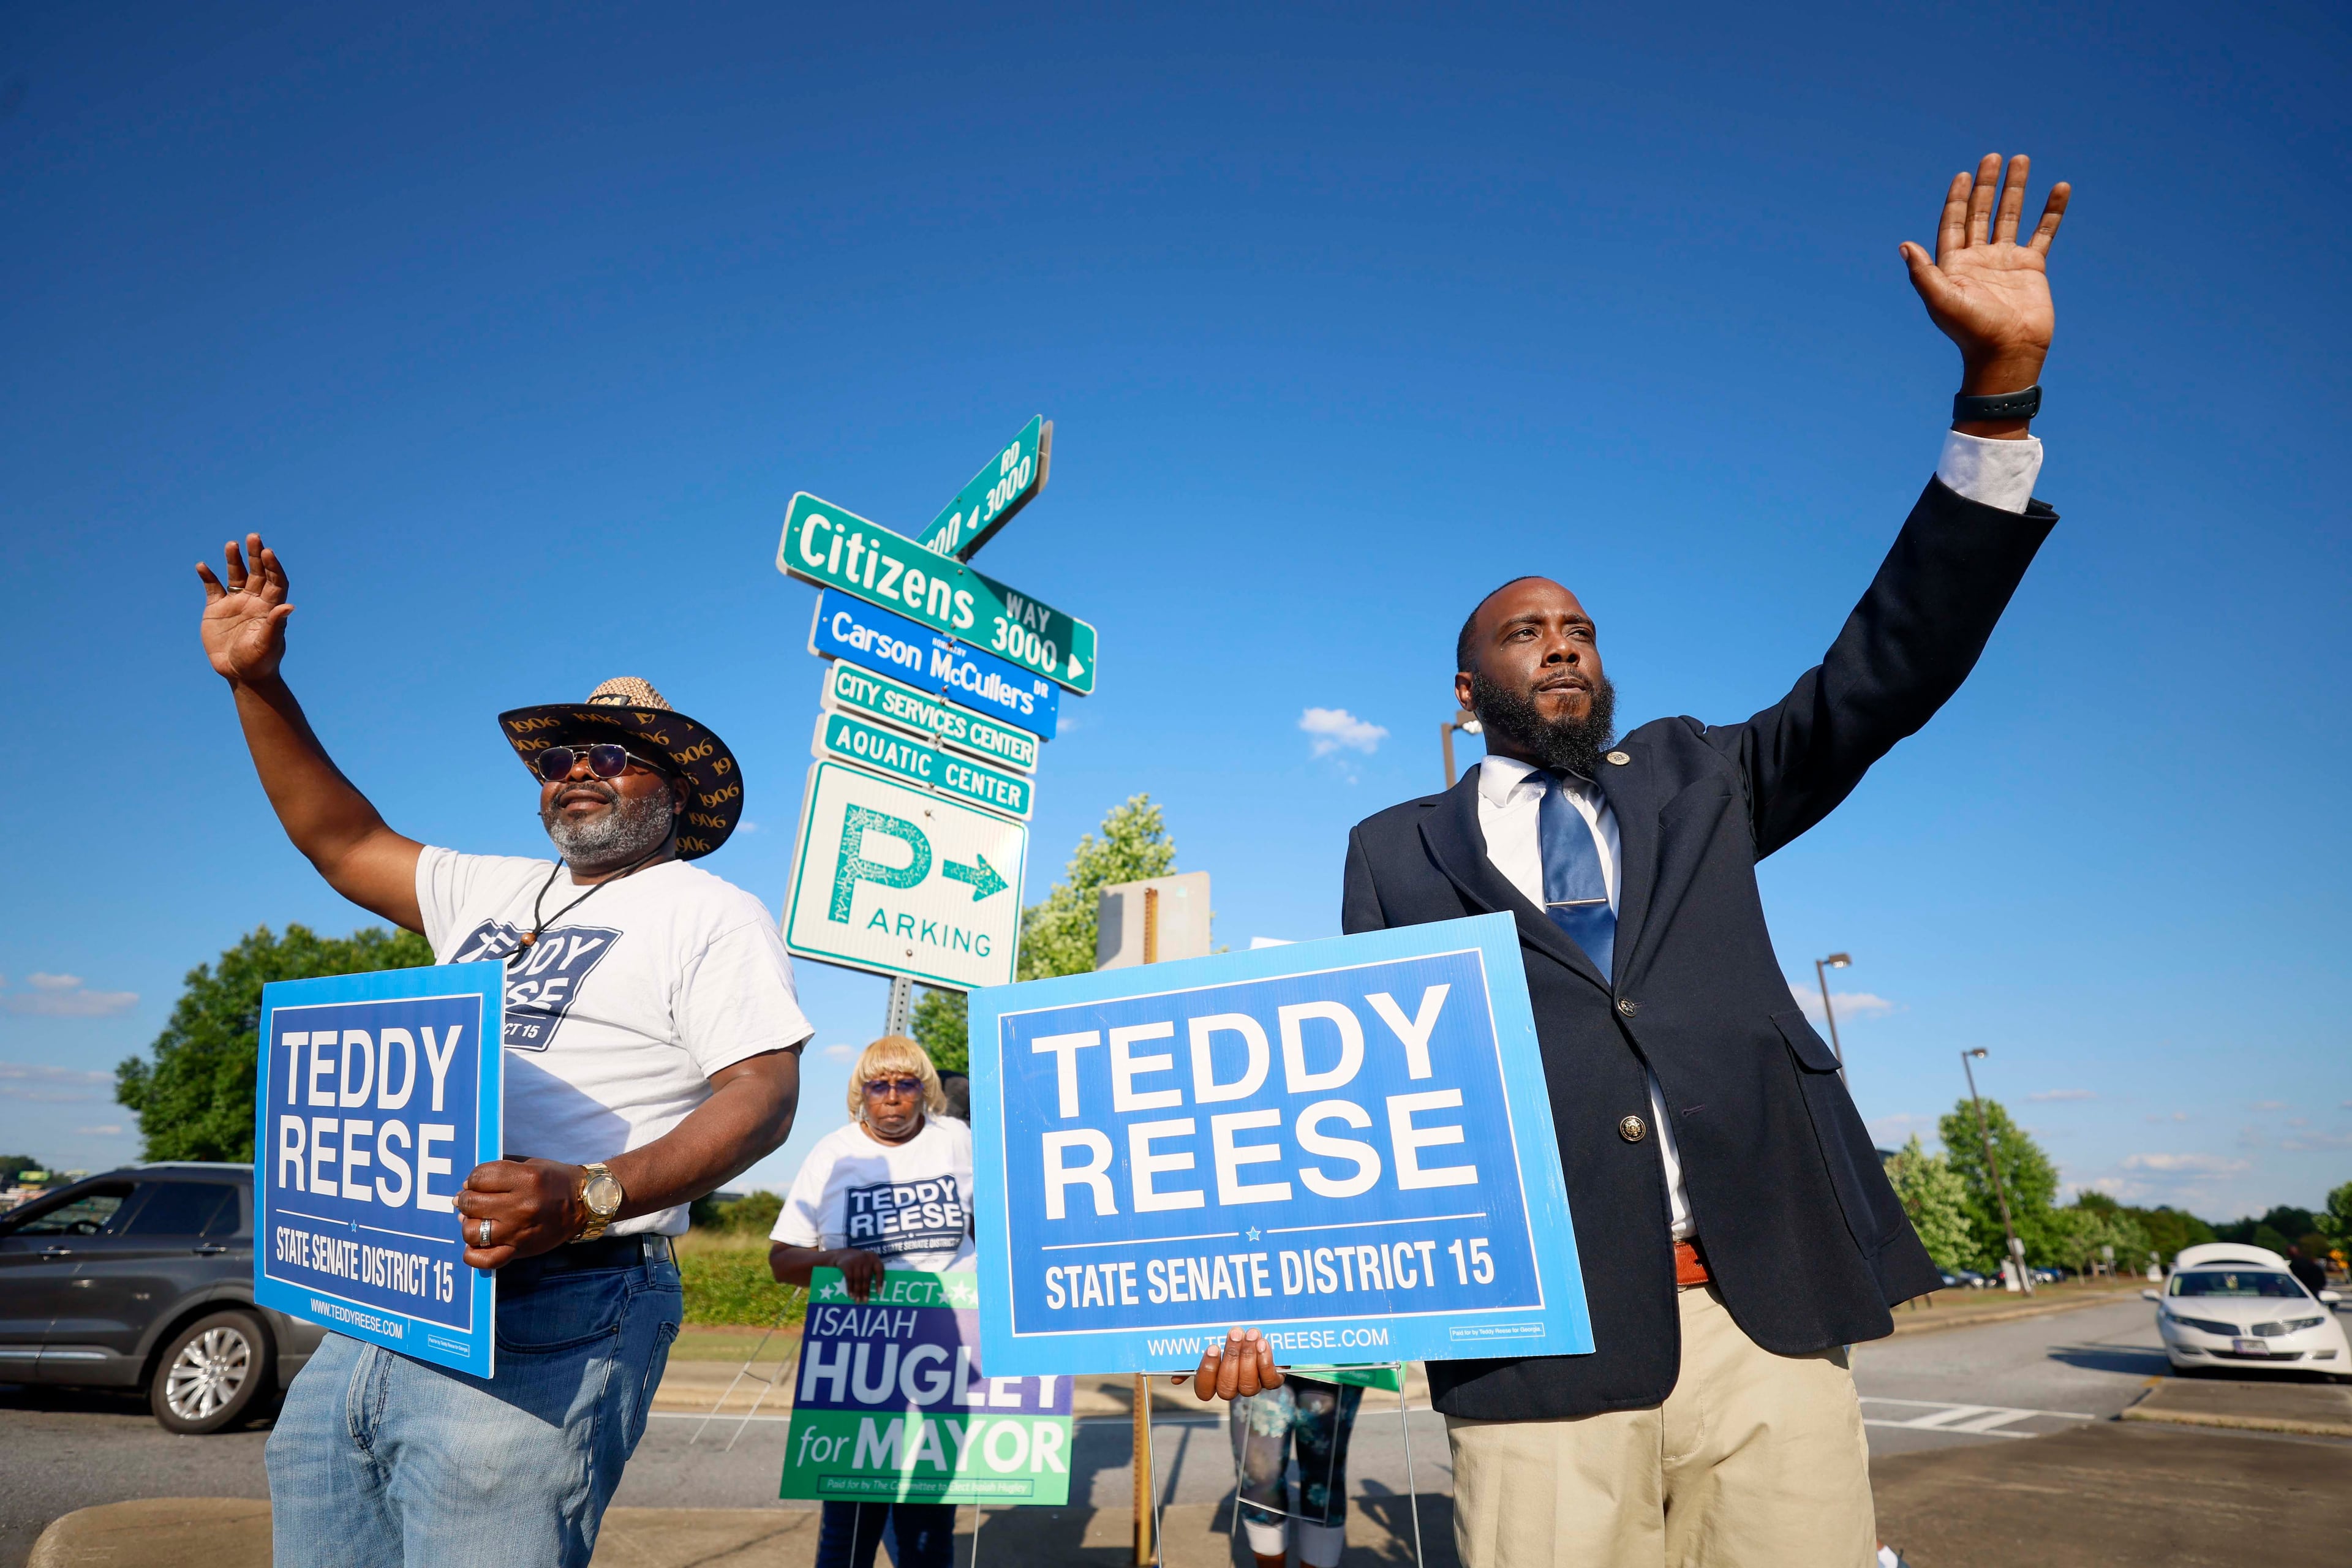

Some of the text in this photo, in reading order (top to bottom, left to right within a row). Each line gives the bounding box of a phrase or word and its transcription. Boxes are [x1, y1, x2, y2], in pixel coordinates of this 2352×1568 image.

[1000, 441, 1020, 477] RD
[984, 456, 1030, 521] 3000
[800, 513, 974, 629] Citizens
[1006, 592, 1050, 631] WAY
[832, 612, 1049, 715] Carson McCullers DR
[992, 617, 1057, 673] 3000
[508, 716, 561, 733] 1906
[837, 672, 1033, 764] CITY SERVICES CENTER
[668, 737, 714, 765] 1906
[836, 725, 1021, 809] AQUATIC CENTER
[699, 780, 739, 809] 1906
[521, 1024, 540, 1038] 15
[1031, 983, 1451, 1118] TEDDY
[281, 1025, 463, 1112] TEDDY
[279, 1114, 454, 1213] REESE
[1041, 1088, 1478, 1219] REESE
[850, 1202, 963, 1238] REESE
[851, 1178, 955, 1212] TEDDY
[276, 1225, 454, 1303] STATE SENATE DISTRICT 15
[882, 1243, 903, 1254] STATE
[903, 1239, 929, 1251] SENATE
[1045, 1238, 1494, 1310] STATE SENATE DISTRICT 15
[310, 1298, 402, 1340] WWW.TEDDYREESE.COM
[812, 1306, 918, 1338] ISAIAH
[797, 1417, 1067, 1474] for MAYOR
[827, 1479, 845, 1489] Paid
[847, 1480, 859, 1489] for
[861, 1481, 870, 1490] by
[873, 1480, 888, 1490] The
[938, 1483, 946, 1491] to
[949, 1481, 970, 1492] Elect
[998, 1483, 1027, 1494] Hugley
